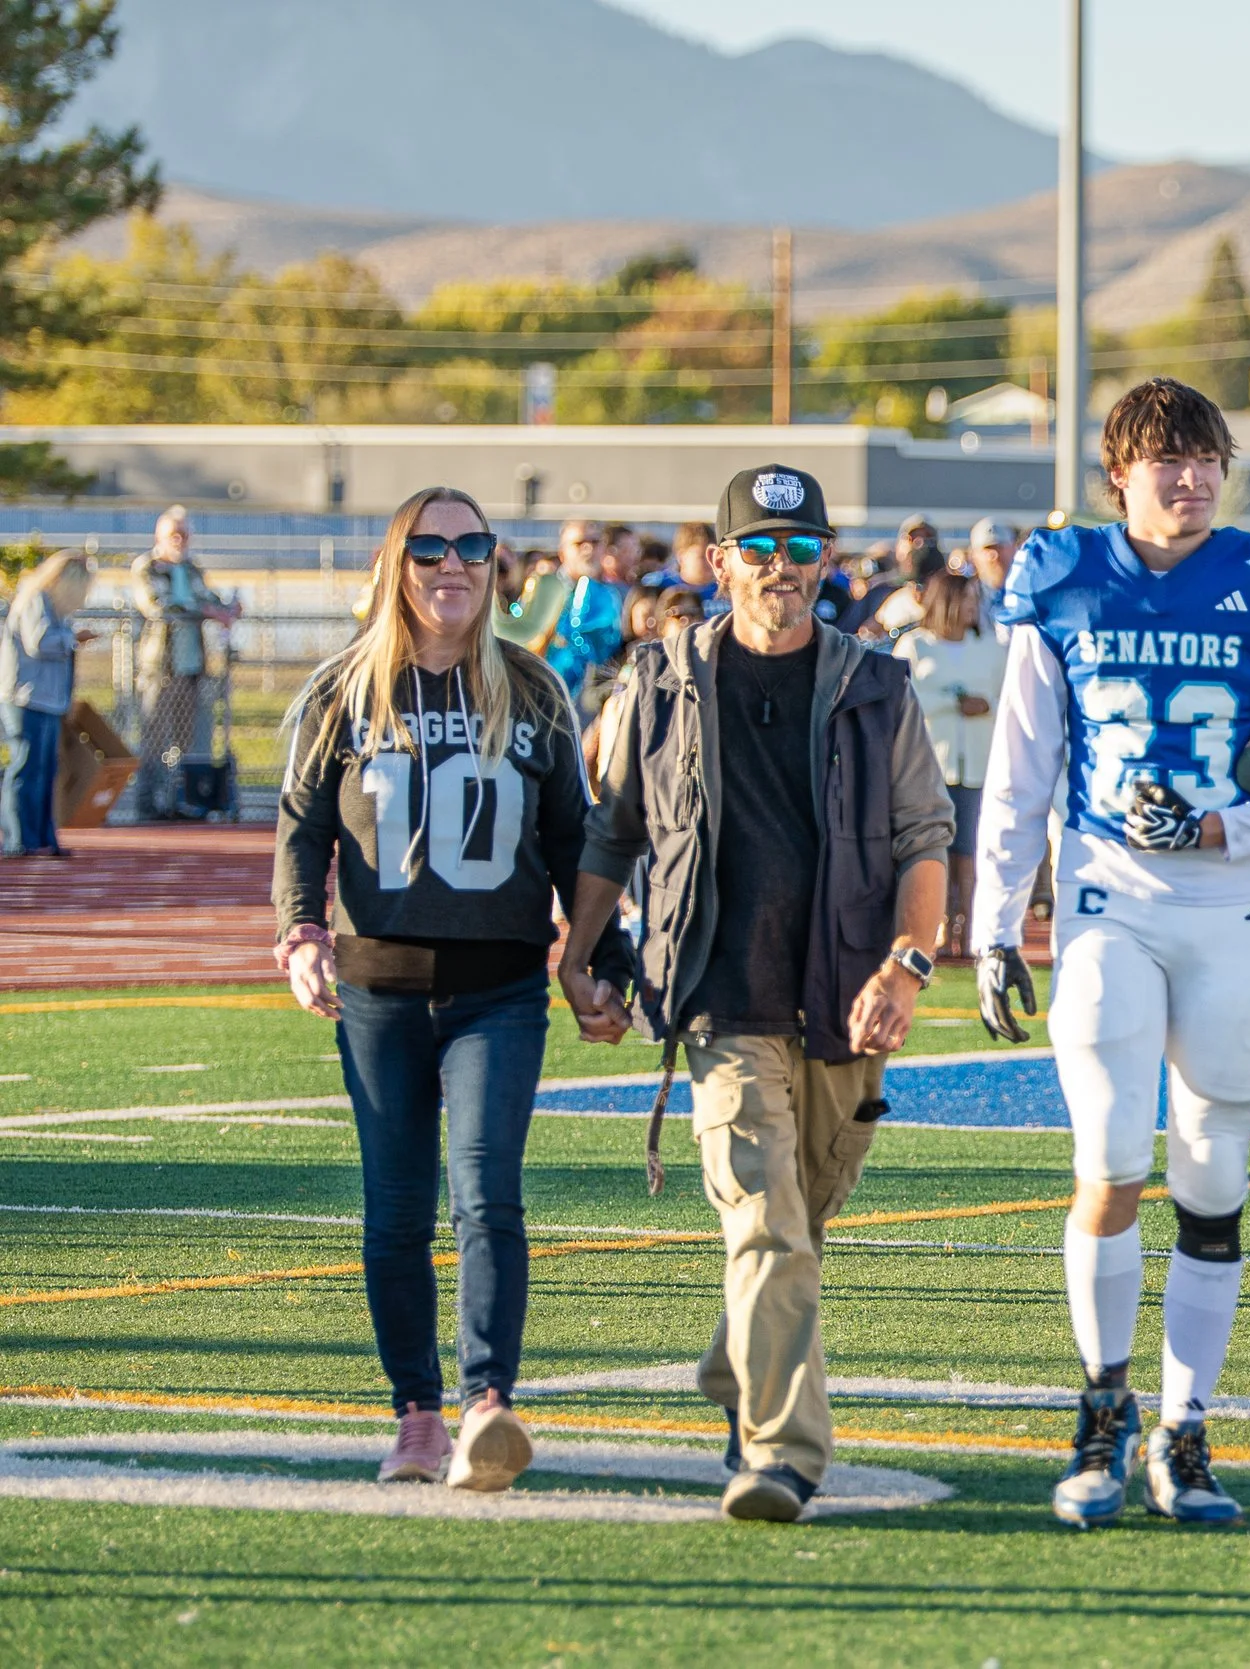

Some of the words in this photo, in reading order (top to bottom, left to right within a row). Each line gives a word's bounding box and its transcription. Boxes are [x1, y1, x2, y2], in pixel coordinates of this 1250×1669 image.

[1078, 630, 1242, 667] SENATORS
[1083, 675, 1239, 817] 23
[362, 752, 523, 890] 10
[1077, 887, 1107, 915] C
